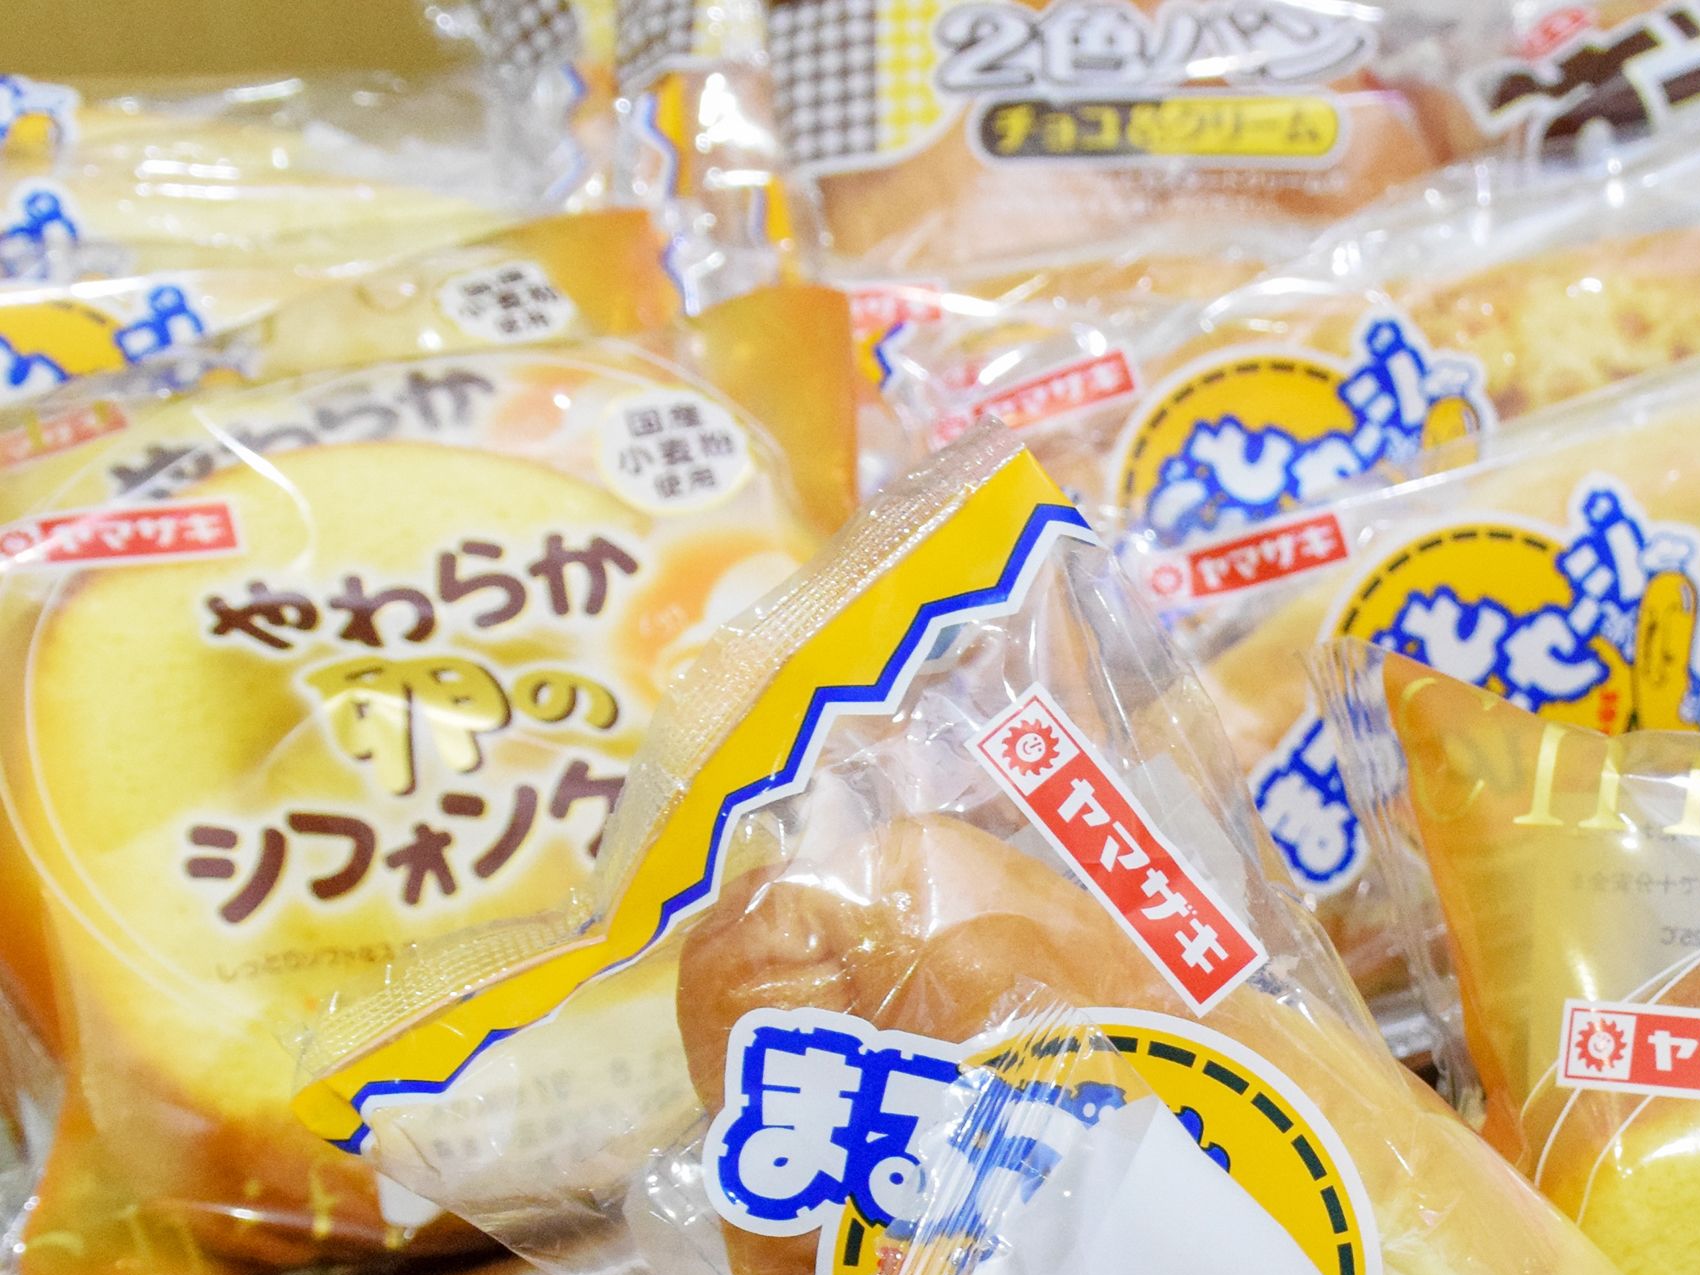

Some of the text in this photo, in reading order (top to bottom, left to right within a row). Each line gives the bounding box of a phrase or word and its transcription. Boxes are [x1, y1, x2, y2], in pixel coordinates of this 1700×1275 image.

[940, 1, 1366, 89] 2色パン
[616, 427, 738, 477] 小麦粉
[626, 401, 705, 440] 国産
[652, 464, 719, 500] 使用
[1199, 522, 1338, 591] ヤマザキ
[204, 533, 640, 650] やわらか
[1050, 774, 1230, 976] ヤマザキ
